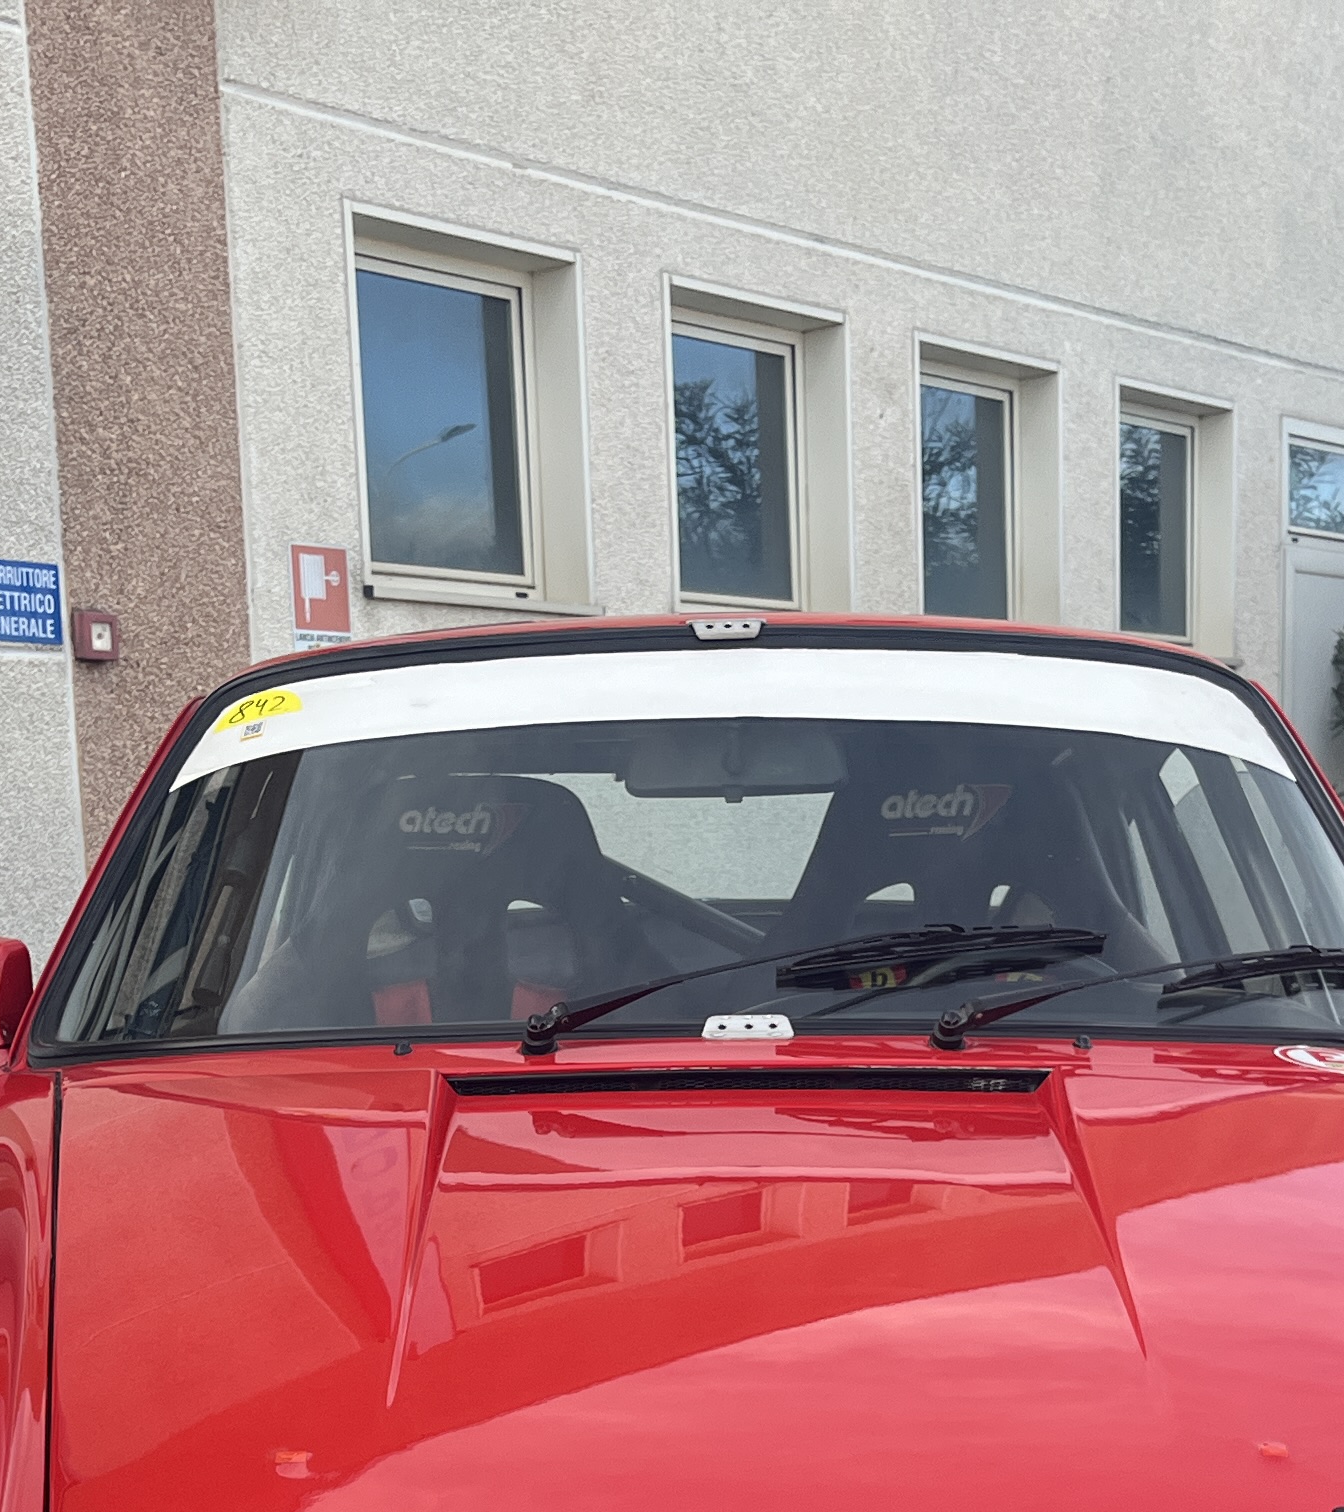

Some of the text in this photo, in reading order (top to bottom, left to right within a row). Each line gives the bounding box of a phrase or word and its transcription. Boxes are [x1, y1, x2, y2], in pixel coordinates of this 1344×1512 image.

[228, 695, 286, 724] 842
[880, 784, 975, 819] atech
[399, 803, 492, 835] atech
